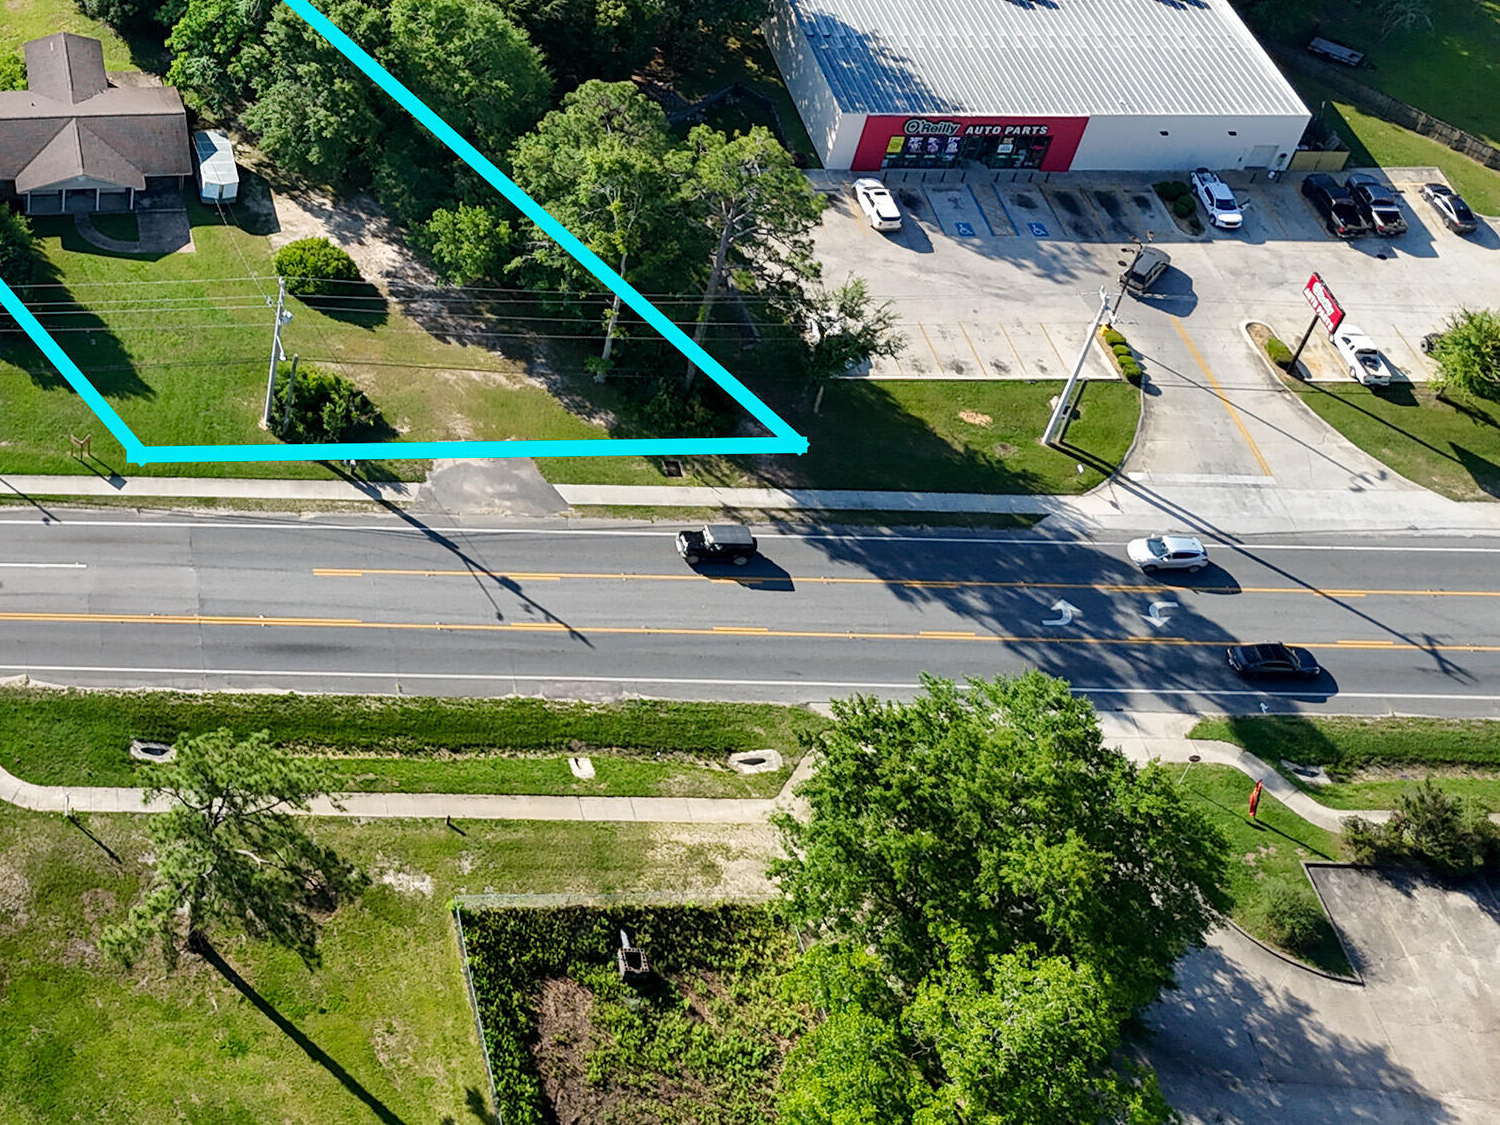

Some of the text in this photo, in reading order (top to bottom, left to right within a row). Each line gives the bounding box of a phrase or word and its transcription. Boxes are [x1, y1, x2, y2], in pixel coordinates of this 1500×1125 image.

[904, 119, 1049, 136] O'Reilly AUTO PARTS
